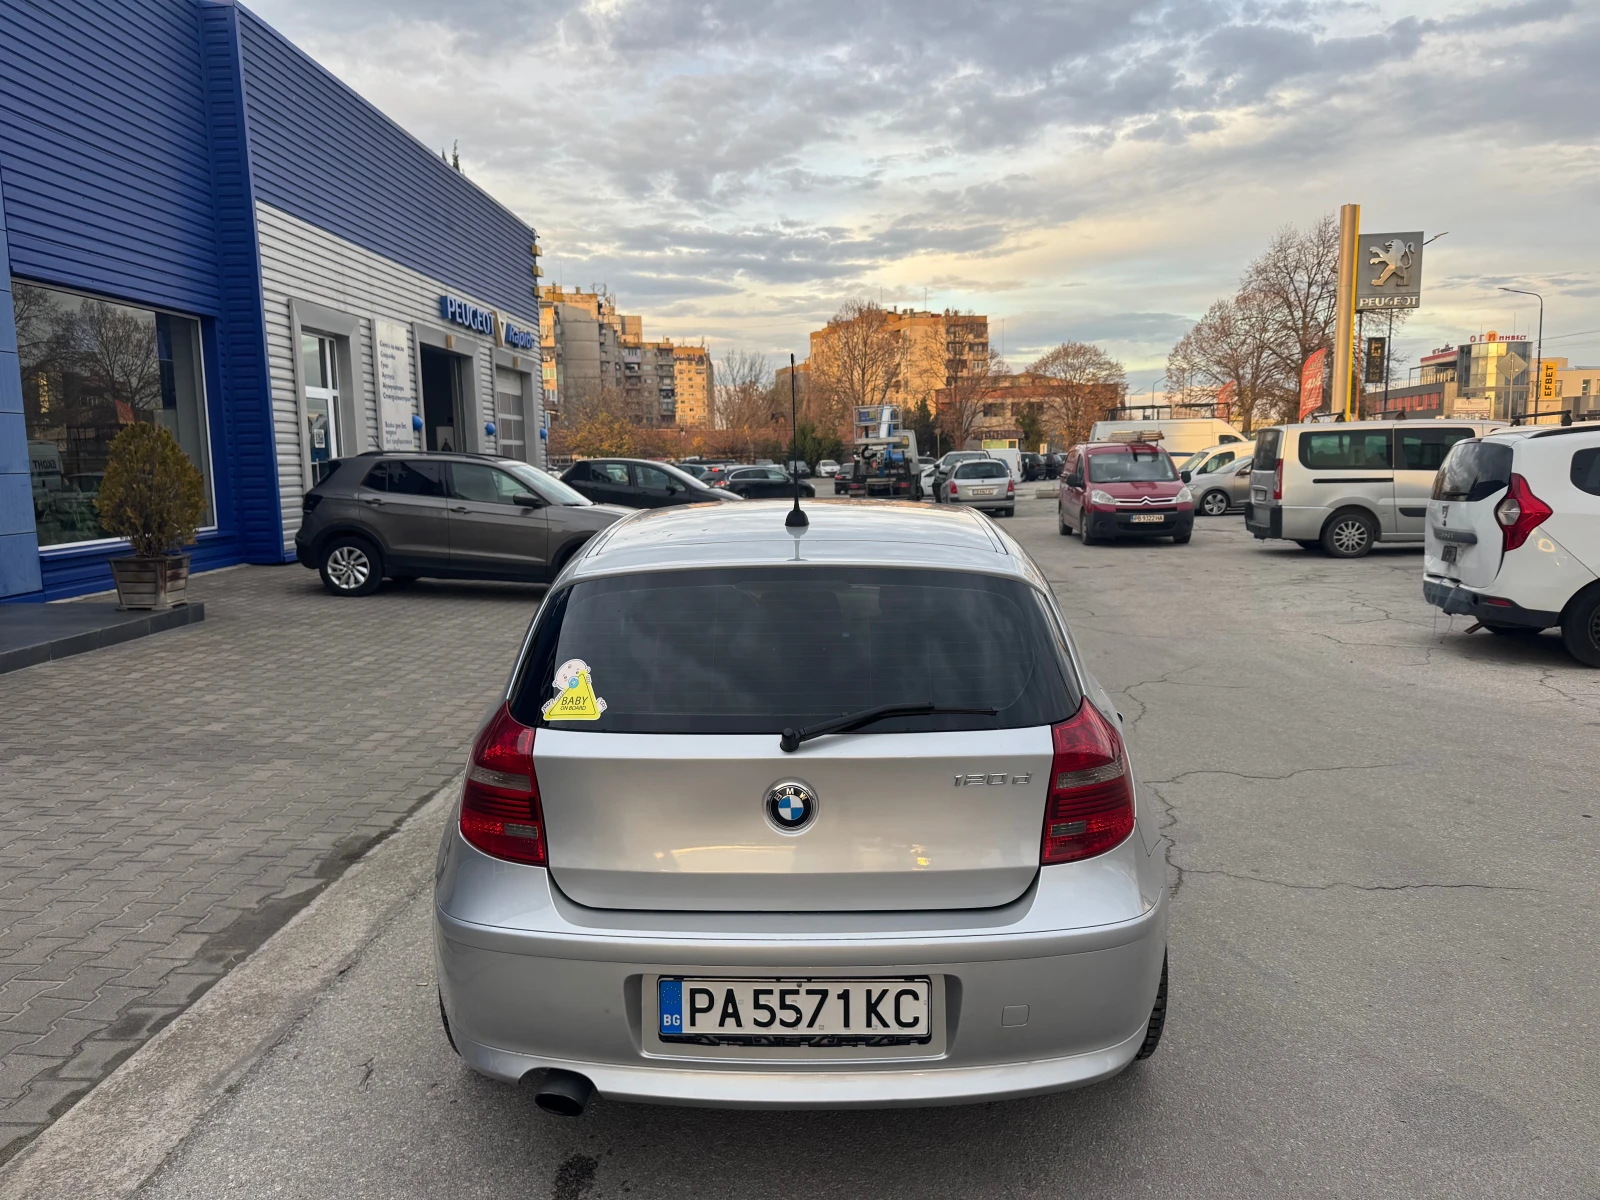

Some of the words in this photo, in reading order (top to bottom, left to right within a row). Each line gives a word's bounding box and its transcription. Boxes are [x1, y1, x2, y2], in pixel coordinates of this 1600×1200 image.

[1359, 296, 1419, 307] PEUGEOT
[447, 296, 495, 335] PEUGEOT
[1544, 365, 1554, 397] EFBET
[561, 696, 588, 706] BABY
[774, 787, 808, 801] BMW
[689, 988, 743, 1028] PA
[753, 988, 850, 1028] 5571
[865, 988, 920, 1028] KC
[663, 1014, 681, 1026] BG
